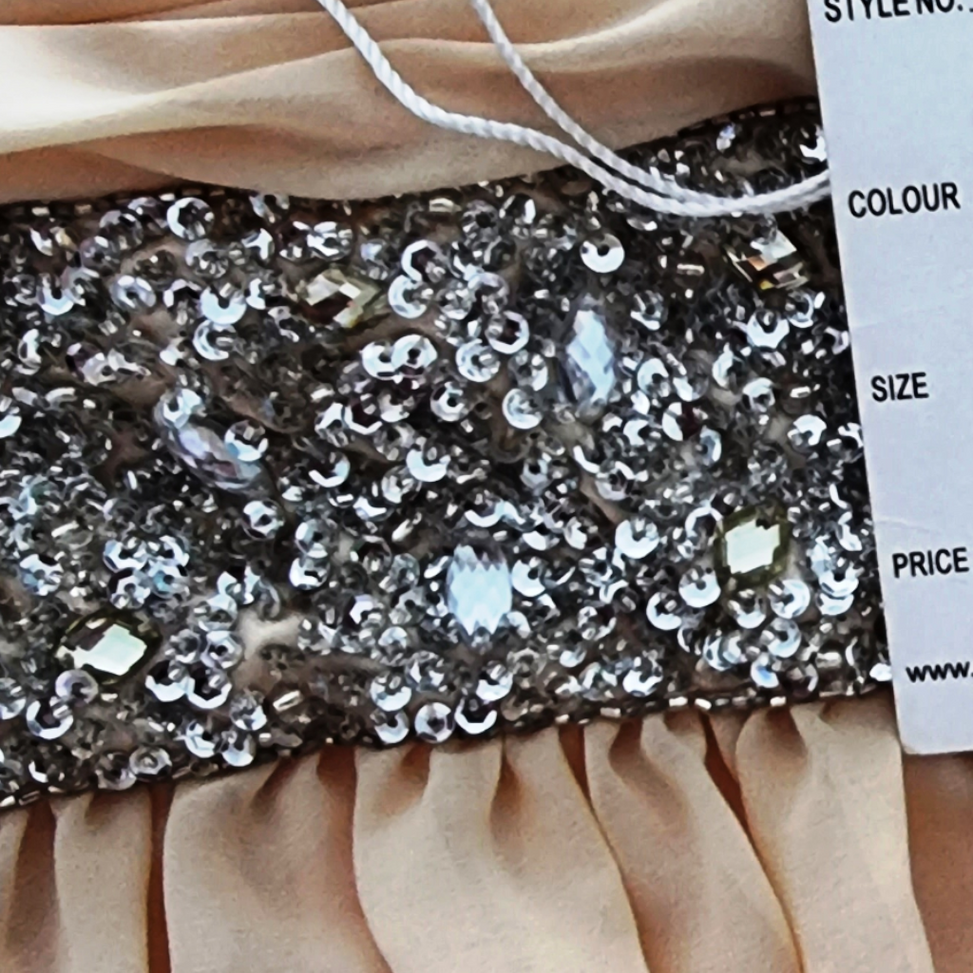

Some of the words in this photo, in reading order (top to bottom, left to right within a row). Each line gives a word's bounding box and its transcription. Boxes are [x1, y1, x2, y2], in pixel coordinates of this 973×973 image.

[848, 182, 961, 218] COLOUR
[871, 372, 930, 403] SIZE
[892, 547, 970, 578] PRICE
